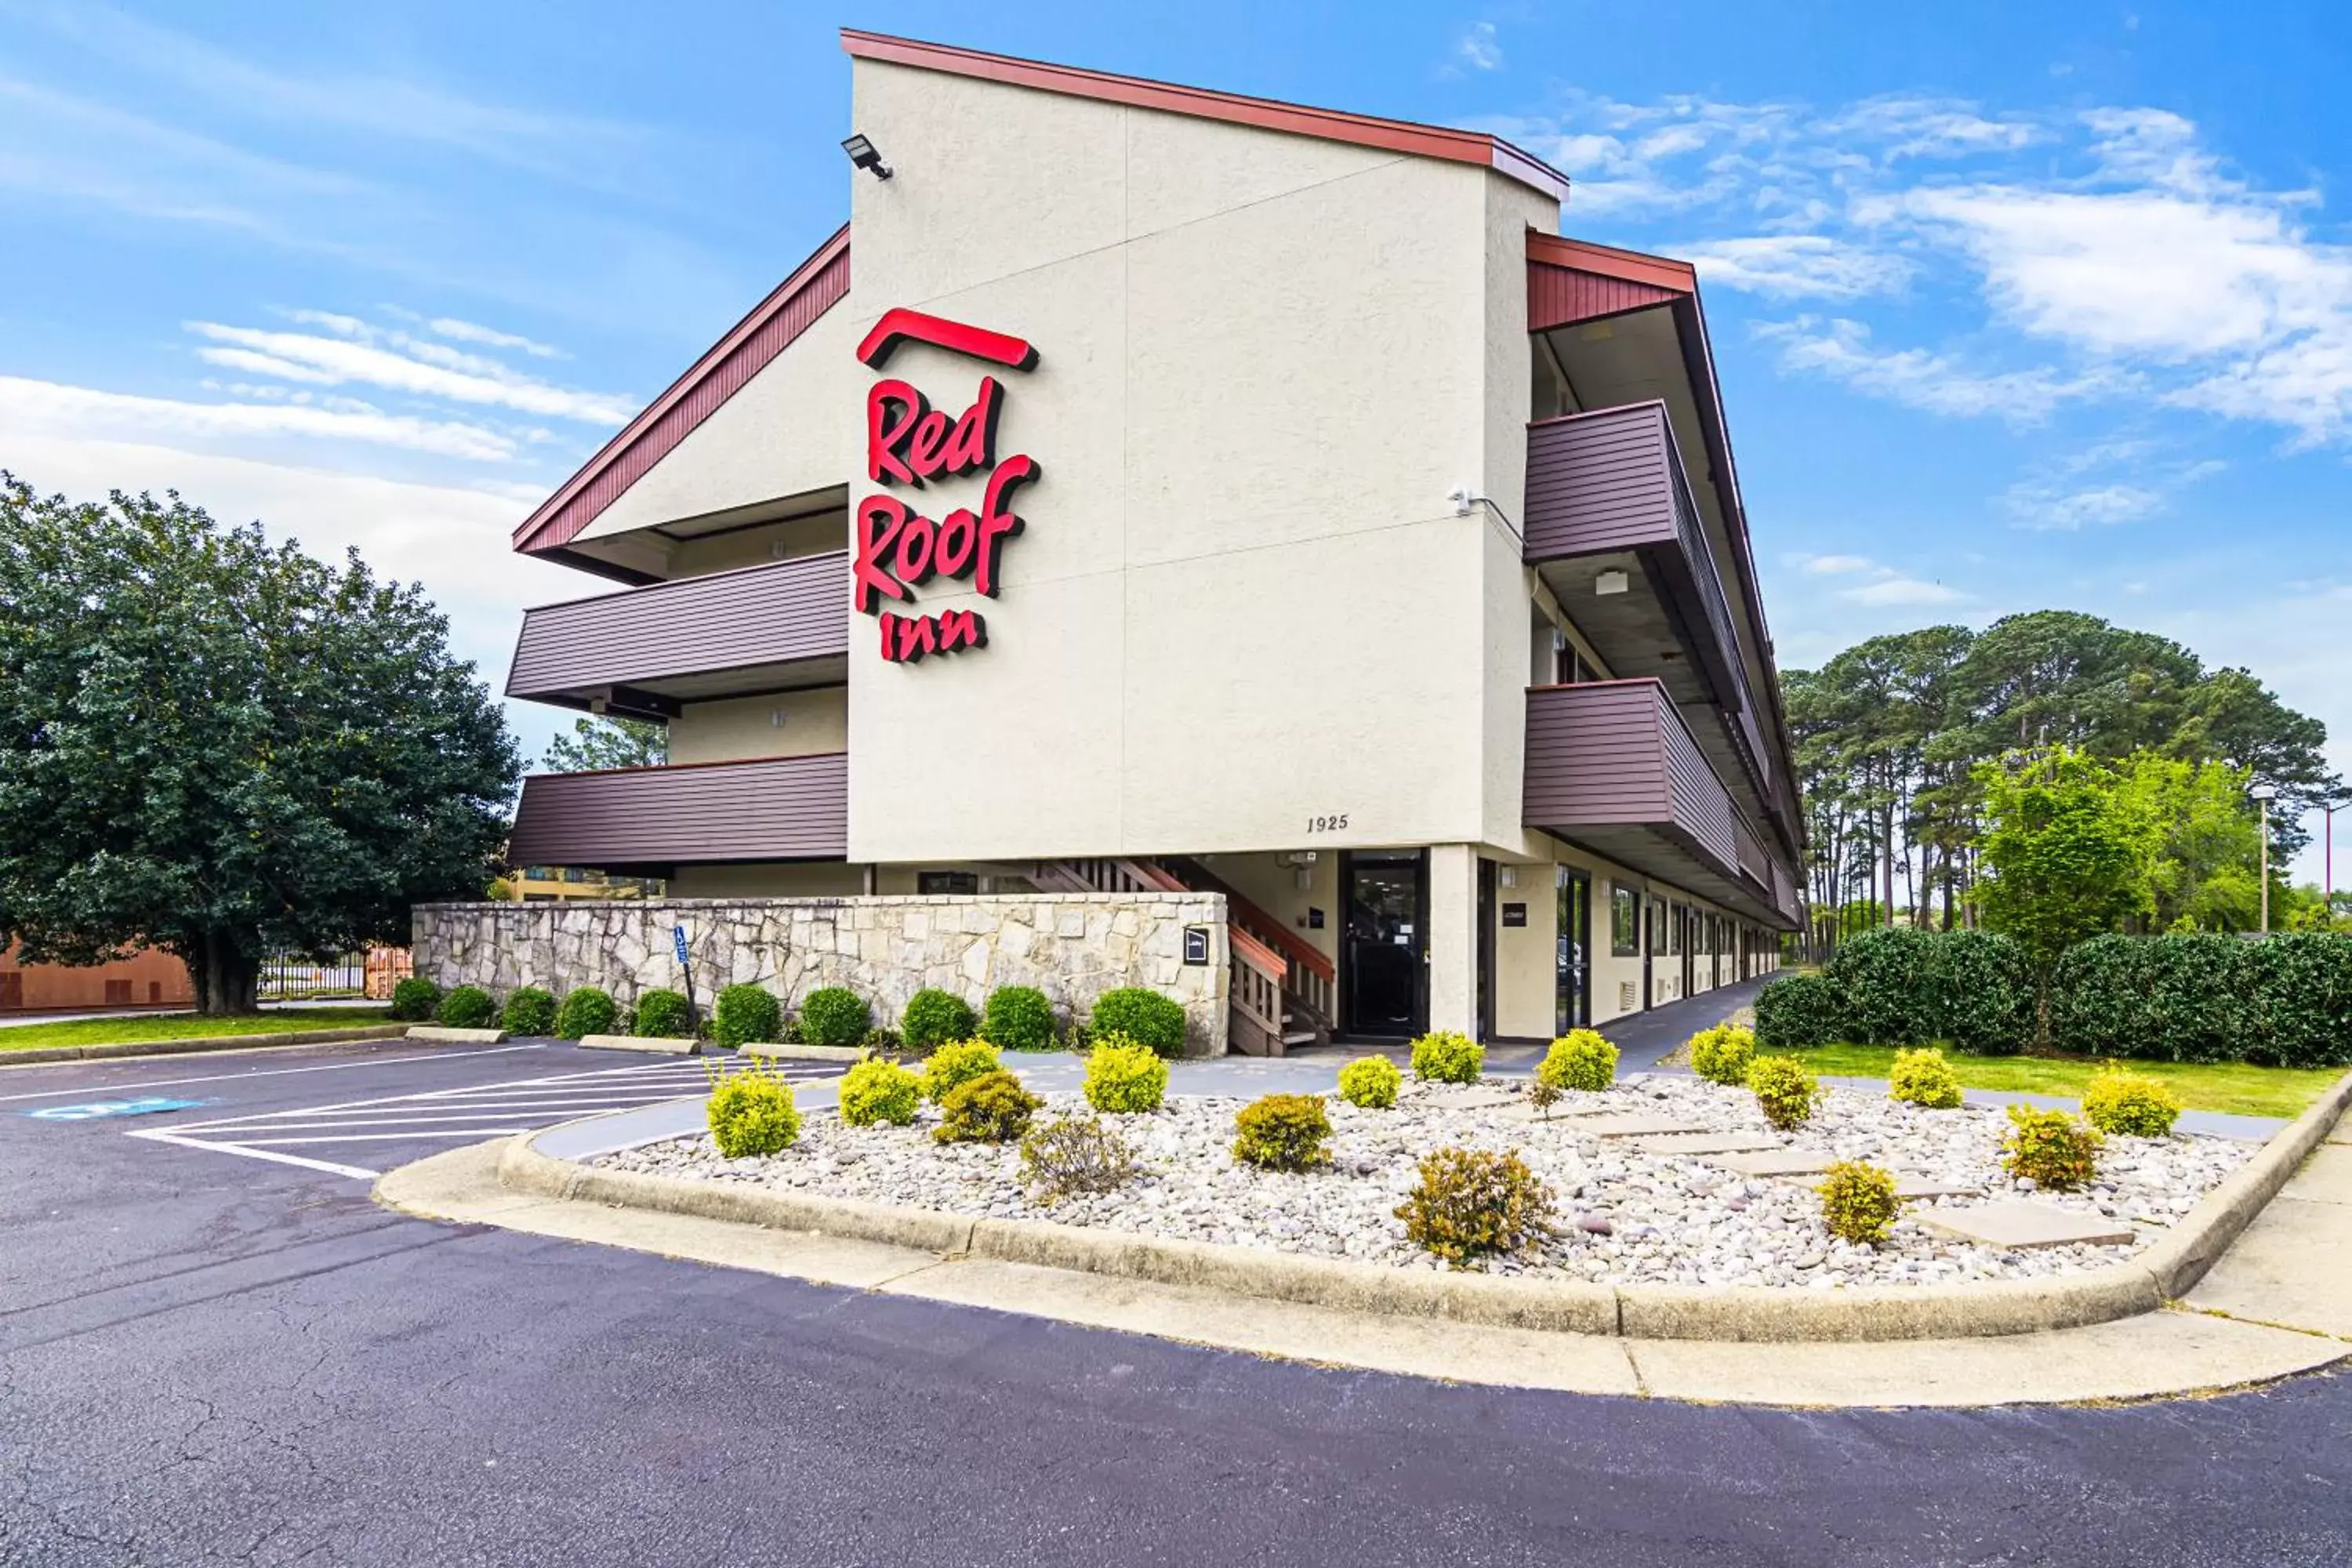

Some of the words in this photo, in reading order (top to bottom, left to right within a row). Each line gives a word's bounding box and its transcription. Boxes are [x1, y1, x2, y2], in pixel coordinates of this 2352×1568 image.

[867, 376, 997, 483] Red
[854, 454, 1033, 612] Roof
[1307, 814, 1348, 833] 1925
